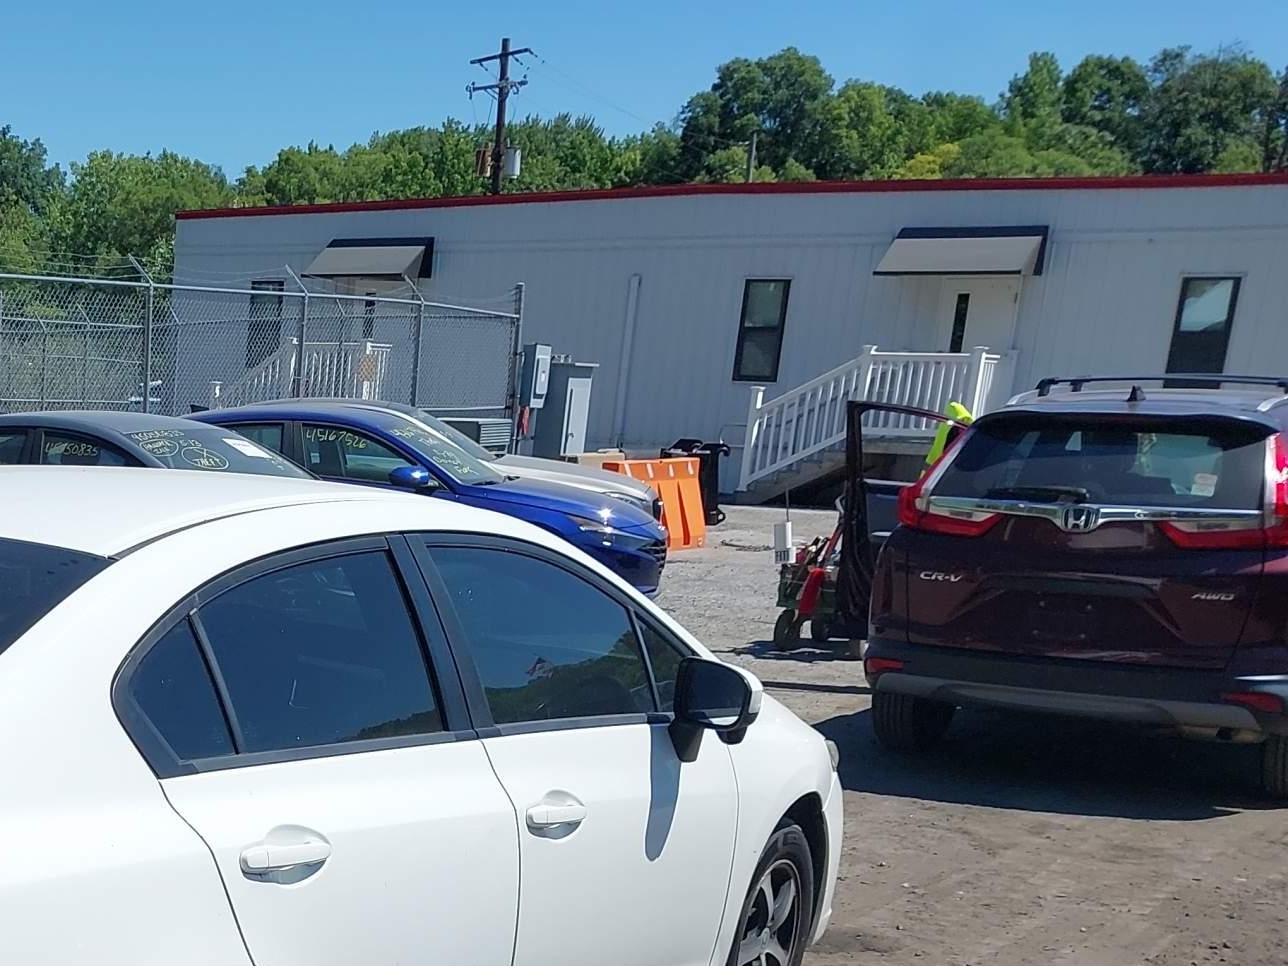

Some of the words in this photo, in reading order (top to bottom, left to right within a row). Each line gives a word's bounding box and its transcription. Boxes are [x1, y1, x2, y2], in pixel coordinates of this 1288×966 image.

[306, 428, 367, 449] 45167526
[919, 571, 962, 582] CR-V
[1191, 592, 1234, 600] AWD
